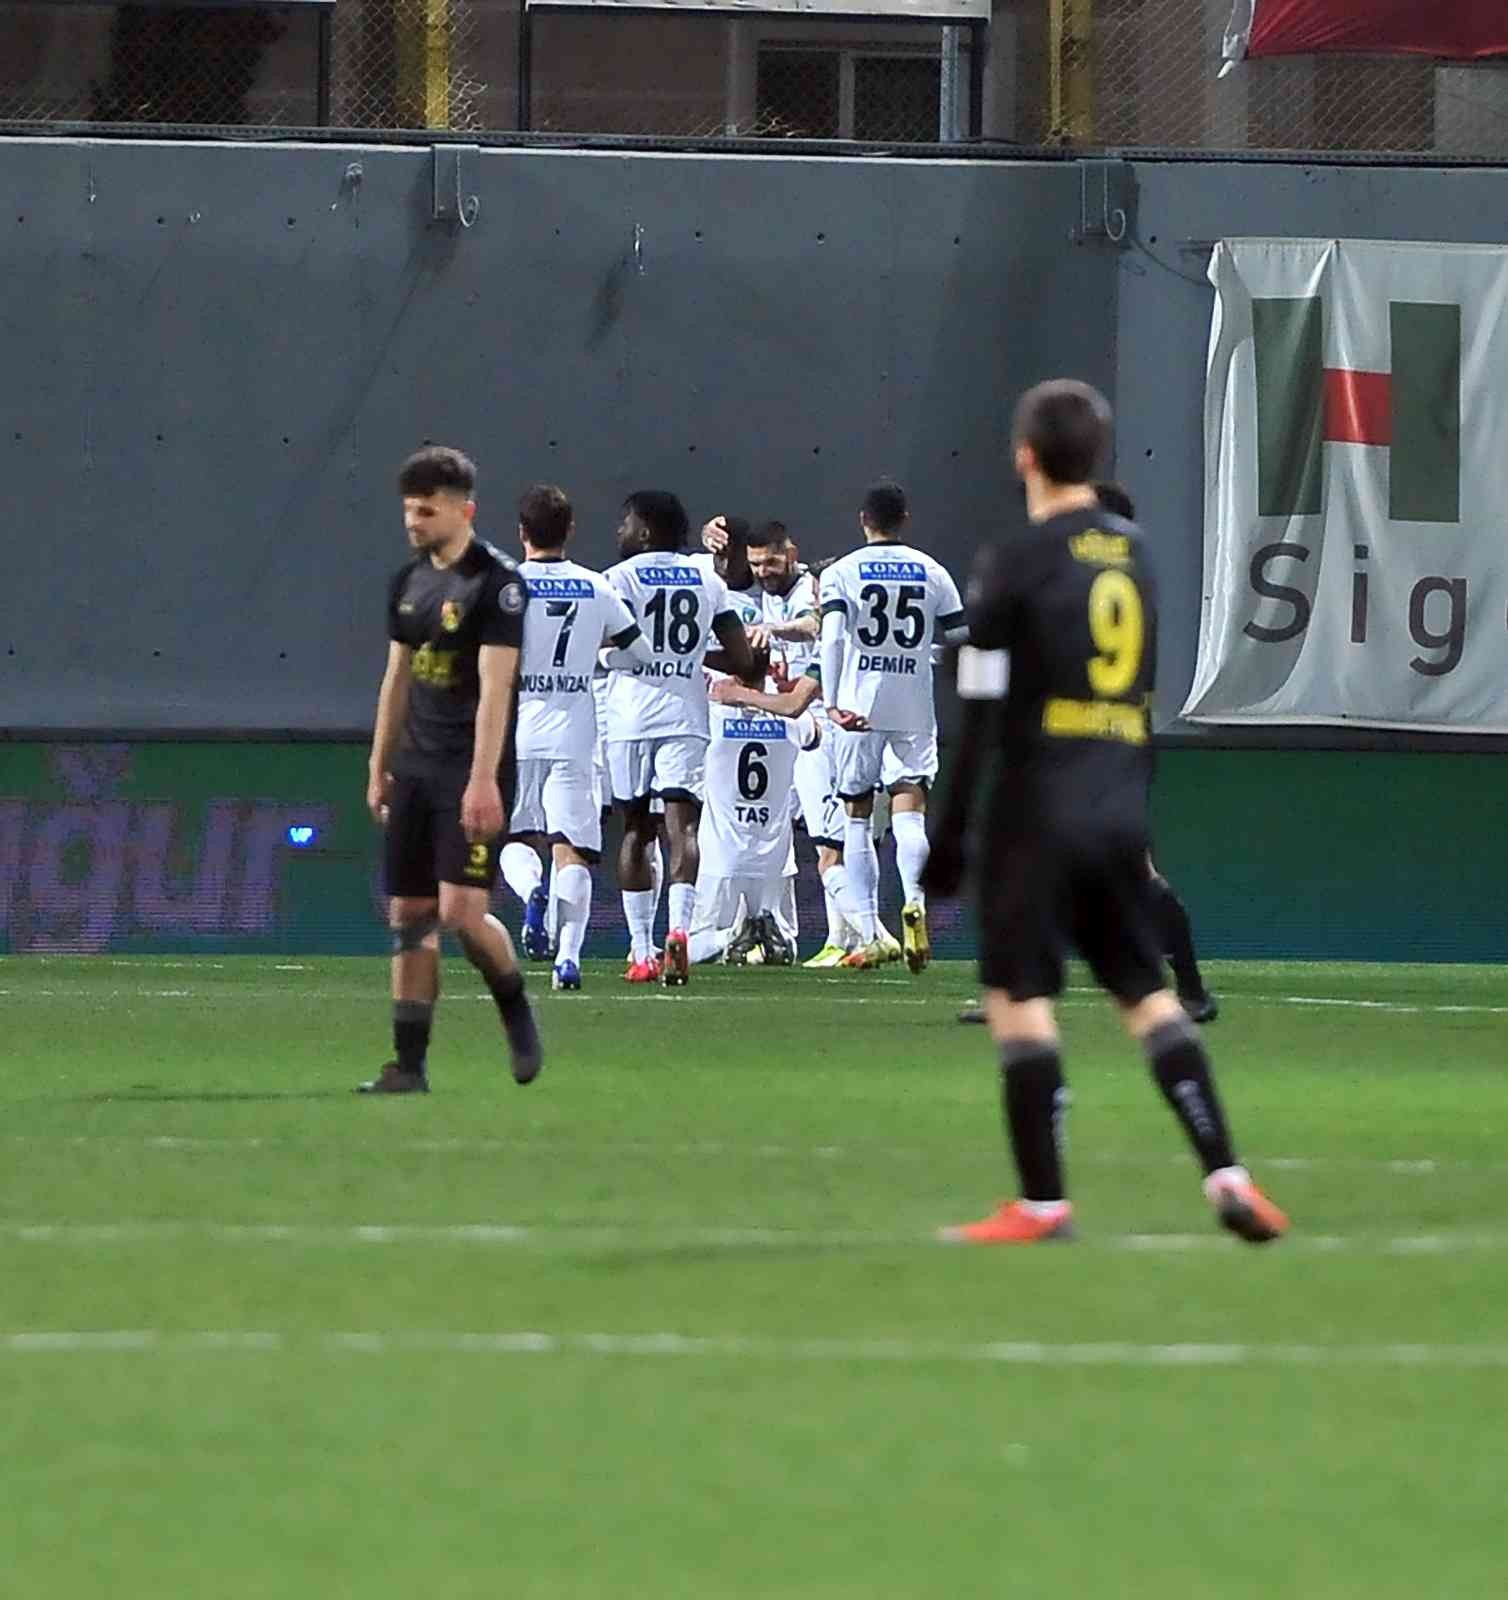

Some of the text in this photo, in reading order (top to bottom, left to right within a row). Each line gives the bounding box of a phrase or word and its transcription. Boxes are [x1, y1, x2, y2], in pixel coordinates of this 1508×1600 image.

[637, 567, 700, 579] KONAK
[860, 562, 924, 574] KONAK
[525, 579, 592, 591] KONAK
[857, 583, 925, 649] 35
[1244, 542, 1508, 676] Sig
[643, 588, 700, 655] 18
[545, 600, 579, 668] 7
[1087, 568, 1144, 697] 9
[858, 654, 917, 674] DEMİR
[725, 719, 784, 732] KONAK
[737, 741, 768, 801] 6
[735, 806, 769, 827] TAŞ
[470, 844, 488, 864] 3
